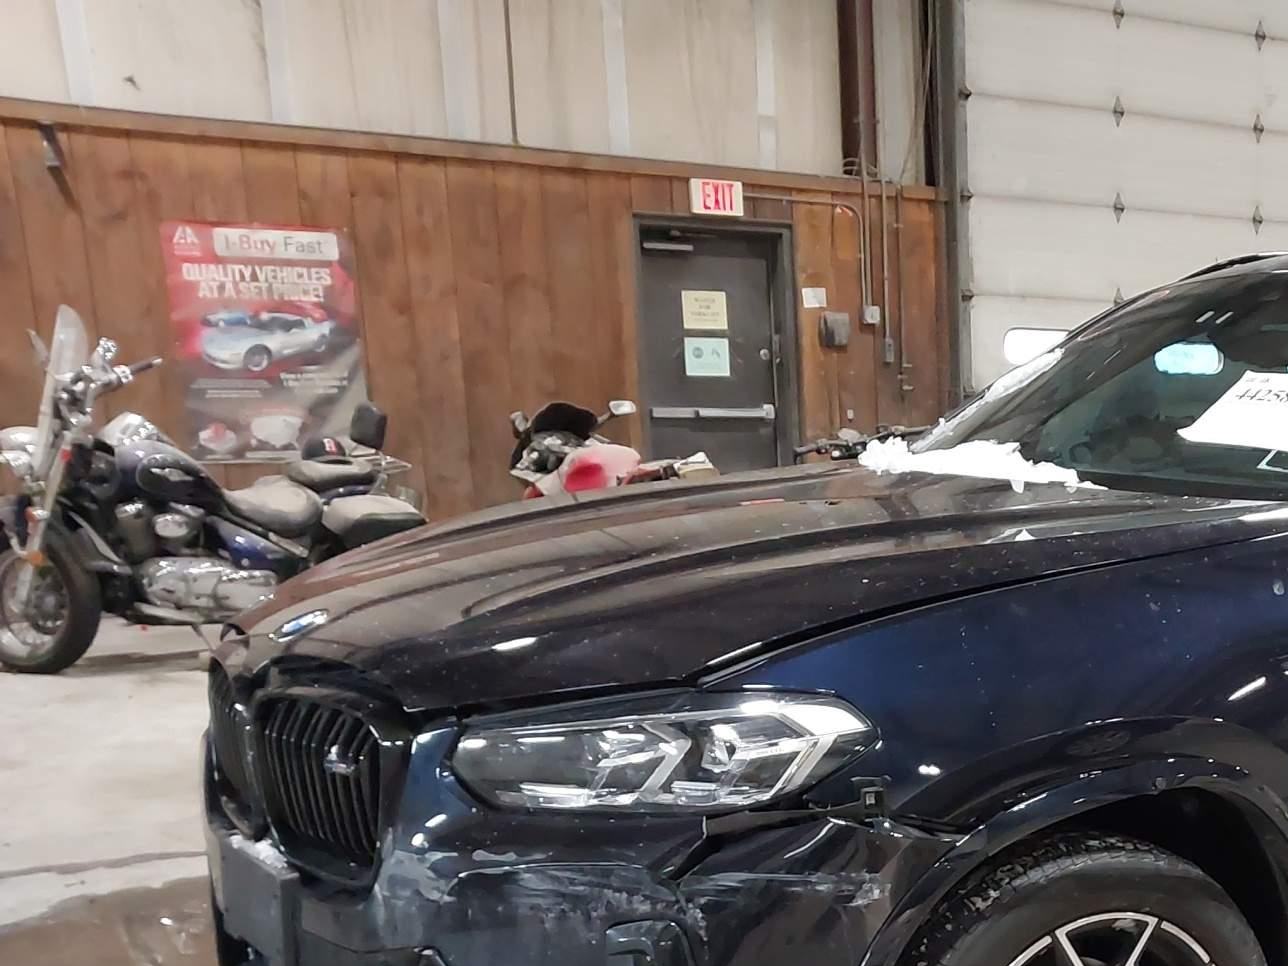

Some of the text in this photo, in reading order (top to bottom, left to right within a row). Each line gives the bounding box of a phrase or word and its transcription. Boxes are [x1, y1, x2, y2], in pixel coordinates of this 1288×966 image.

[702, 181, 734, 211] EXIT
[283, 236, 324, 254] Fast
[182, 262, 332, 285] QUALITY VEHICLES
[198, 281, 222, 298] AT
[224, 282, 237, 299] A
[239, 282, 269, 299] SET
